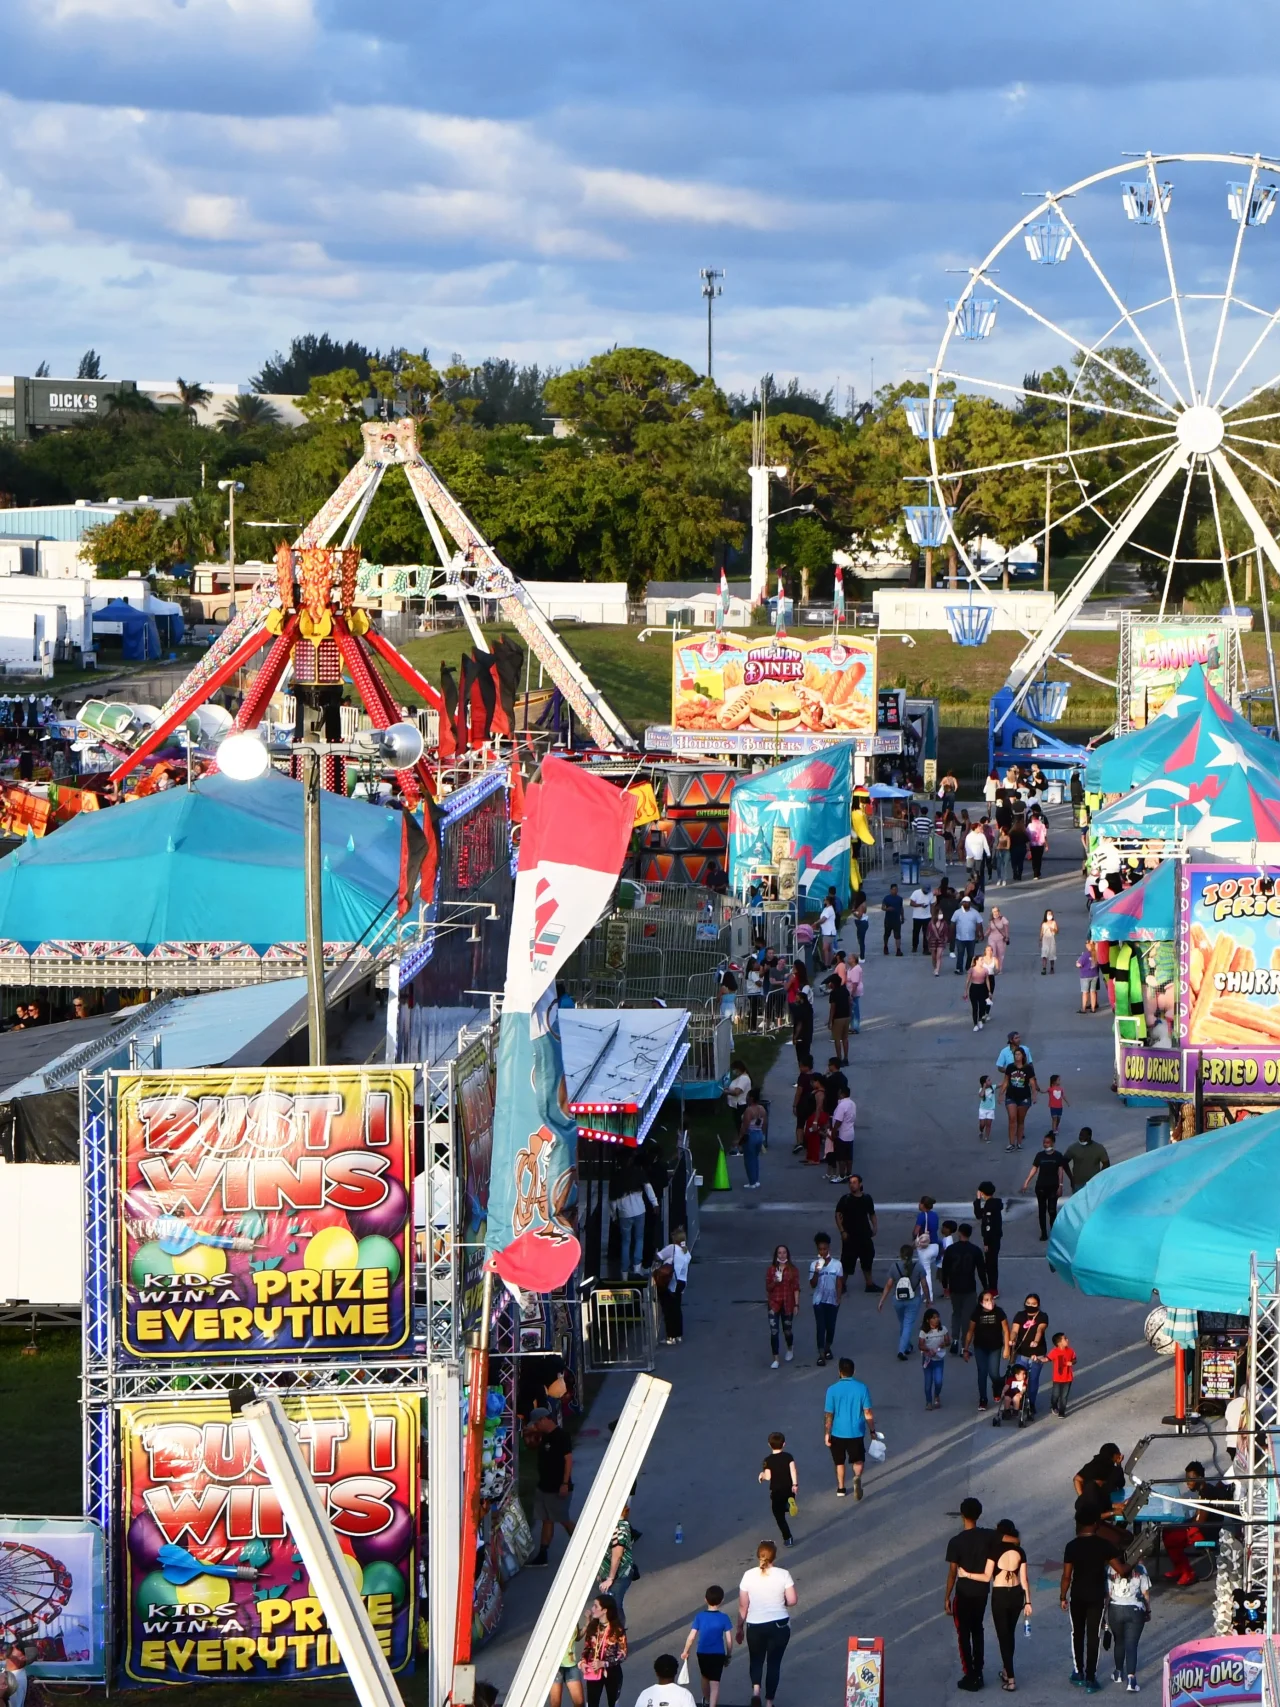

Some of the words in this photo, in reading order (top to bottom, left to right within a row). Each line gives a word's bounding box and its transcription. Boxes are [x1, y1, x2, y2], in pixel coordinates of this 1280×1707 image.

[49, 393, 98, 409] DICK'S
[1138, 636, 1209, 669] LEMONAD
[745, 661, 803, 684] DINER
[676, 735, 736, 750] HOTDOGS
[743, 737, 801, 752] BURGERS
[1124, 1056, 1145, 1081] COLD
[1202, 1058, 1258, 1086] FRIED
[141, 1092, 342, 1154] BUST
[364, 1092, 391, 1148] I
[139, 1150, 391, 1216] WINS
[144, 1272, 234, 1289] KIDS
[253, 1267, 389, 1305] PRIZE
[138, 1290, 212, 1304] WIN
[217, 1289, 241, 1302] A
[600, 1293, 630, 1301] ENTER
[136, 1304, 389, 1342] EVERYTIME
[143, 1419, 349, 1483] BUT
[370, 1416, 396, 1471] I
[147, 1602, 239, 1618] KIDS
[257, 1593, 393, 1634] PRE
[143, 1620, 214, 1635] WIN
[220, 1618, 245, 1633] A
